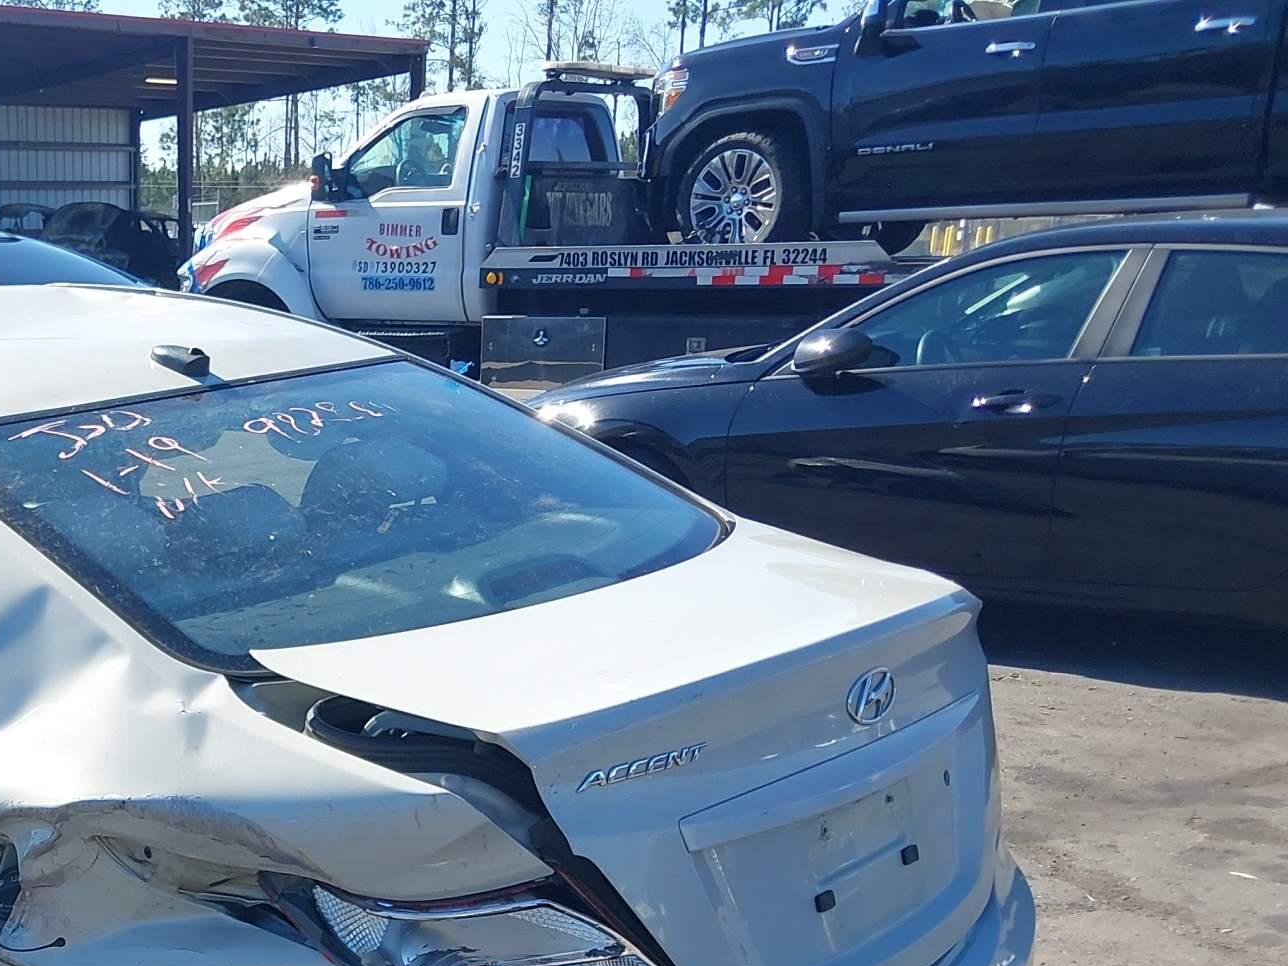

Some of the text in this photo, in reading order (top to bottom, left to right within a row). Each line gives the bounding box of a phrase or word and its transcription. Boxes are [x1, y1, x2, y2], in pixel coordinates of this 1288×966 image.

[511, 123, 525, 178] 3342
[857, 142, 934, 156] DENALI
[366, 236, 439, 259] TOWING
[559, 252, 588, 267] 7403
[592, 250, 638, 267] ROSLYN
[641, 250, 658, 266] RD
[763, 249, 777, 266] FL
[782, 247, 827, 265] 32244
[360, 277, 435, 291] 786-250-9612
[576, 742, 707, 793] ACCENT
